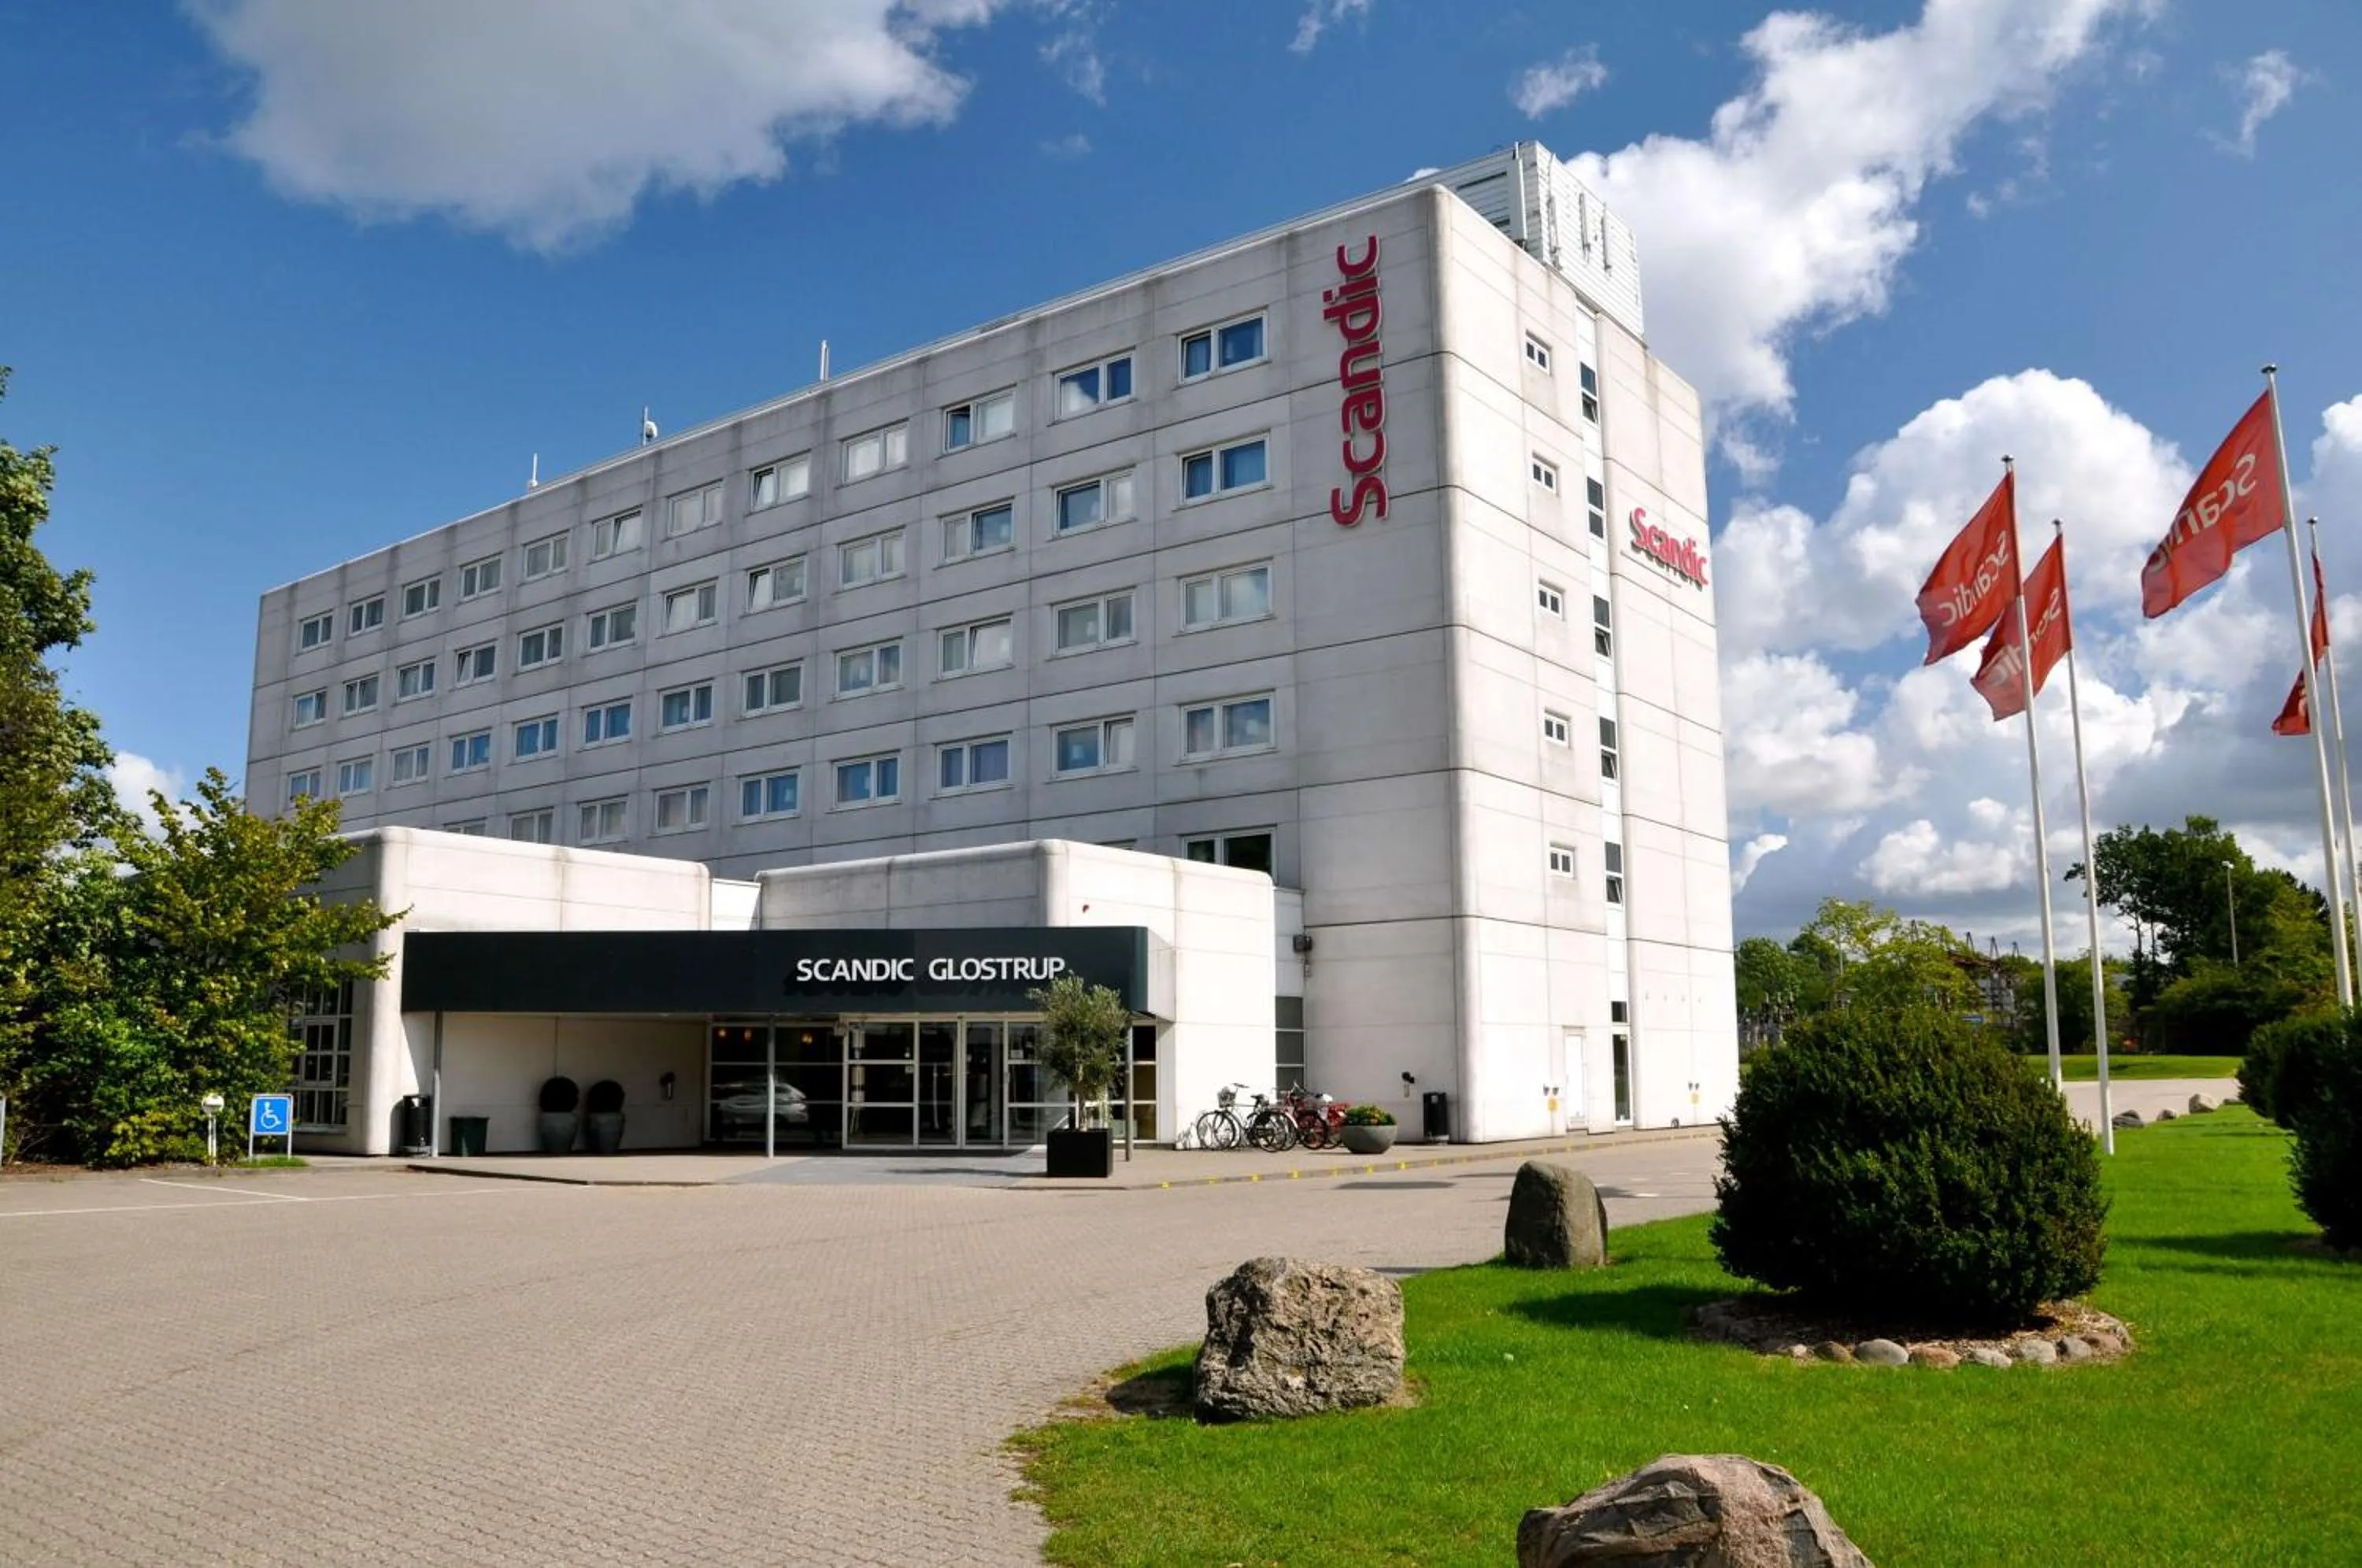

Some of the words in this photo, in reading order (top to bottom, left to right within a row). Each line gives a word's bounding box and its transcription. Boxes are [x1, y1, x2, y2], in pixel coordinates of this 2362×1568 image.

[1323, 235, 1388, 527] Scandic
[1633, 507, 1709, 586] Scandic
[796, 958, 914, 982] SCANDIC
[928, 957, 1064, 981] GLOSTRUP
